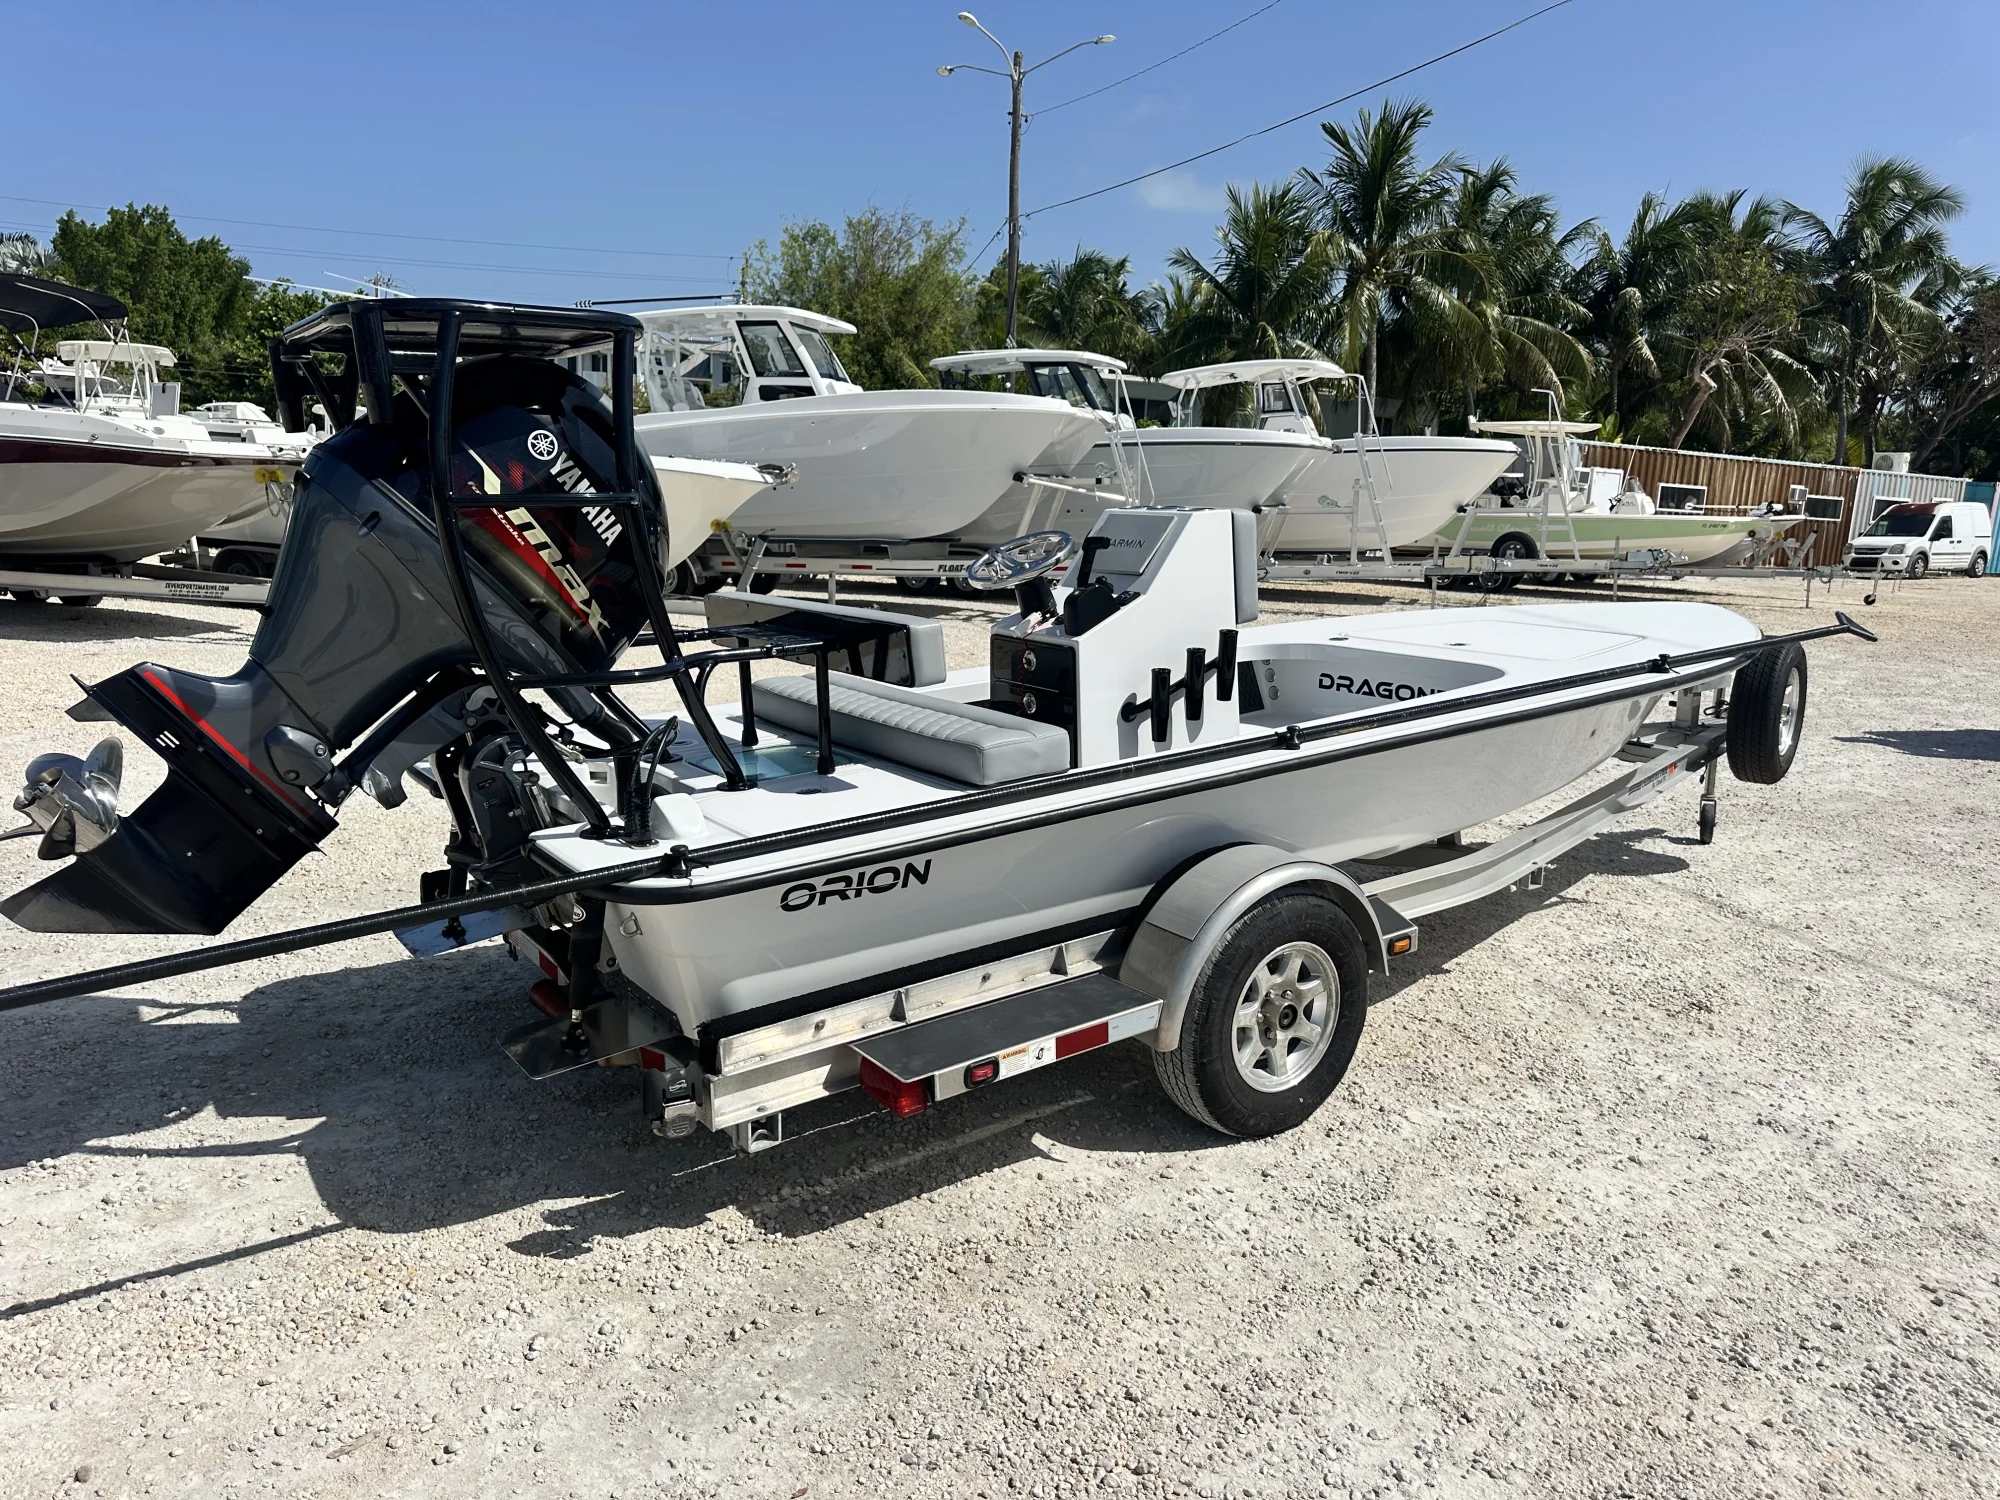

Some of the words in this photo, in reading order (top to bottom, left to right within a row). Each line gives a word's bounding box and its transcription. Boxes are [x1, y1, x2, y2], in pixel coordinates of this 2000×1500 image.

[550, 451, 623, 547] YAMAHA
[1109, 538, 1146, 549] ARMIN
[937, 564, 972, 573] FLOAT-
[1318, 672, 1446, 701] DRAGON
[776, 858, 933, 913] ORION
